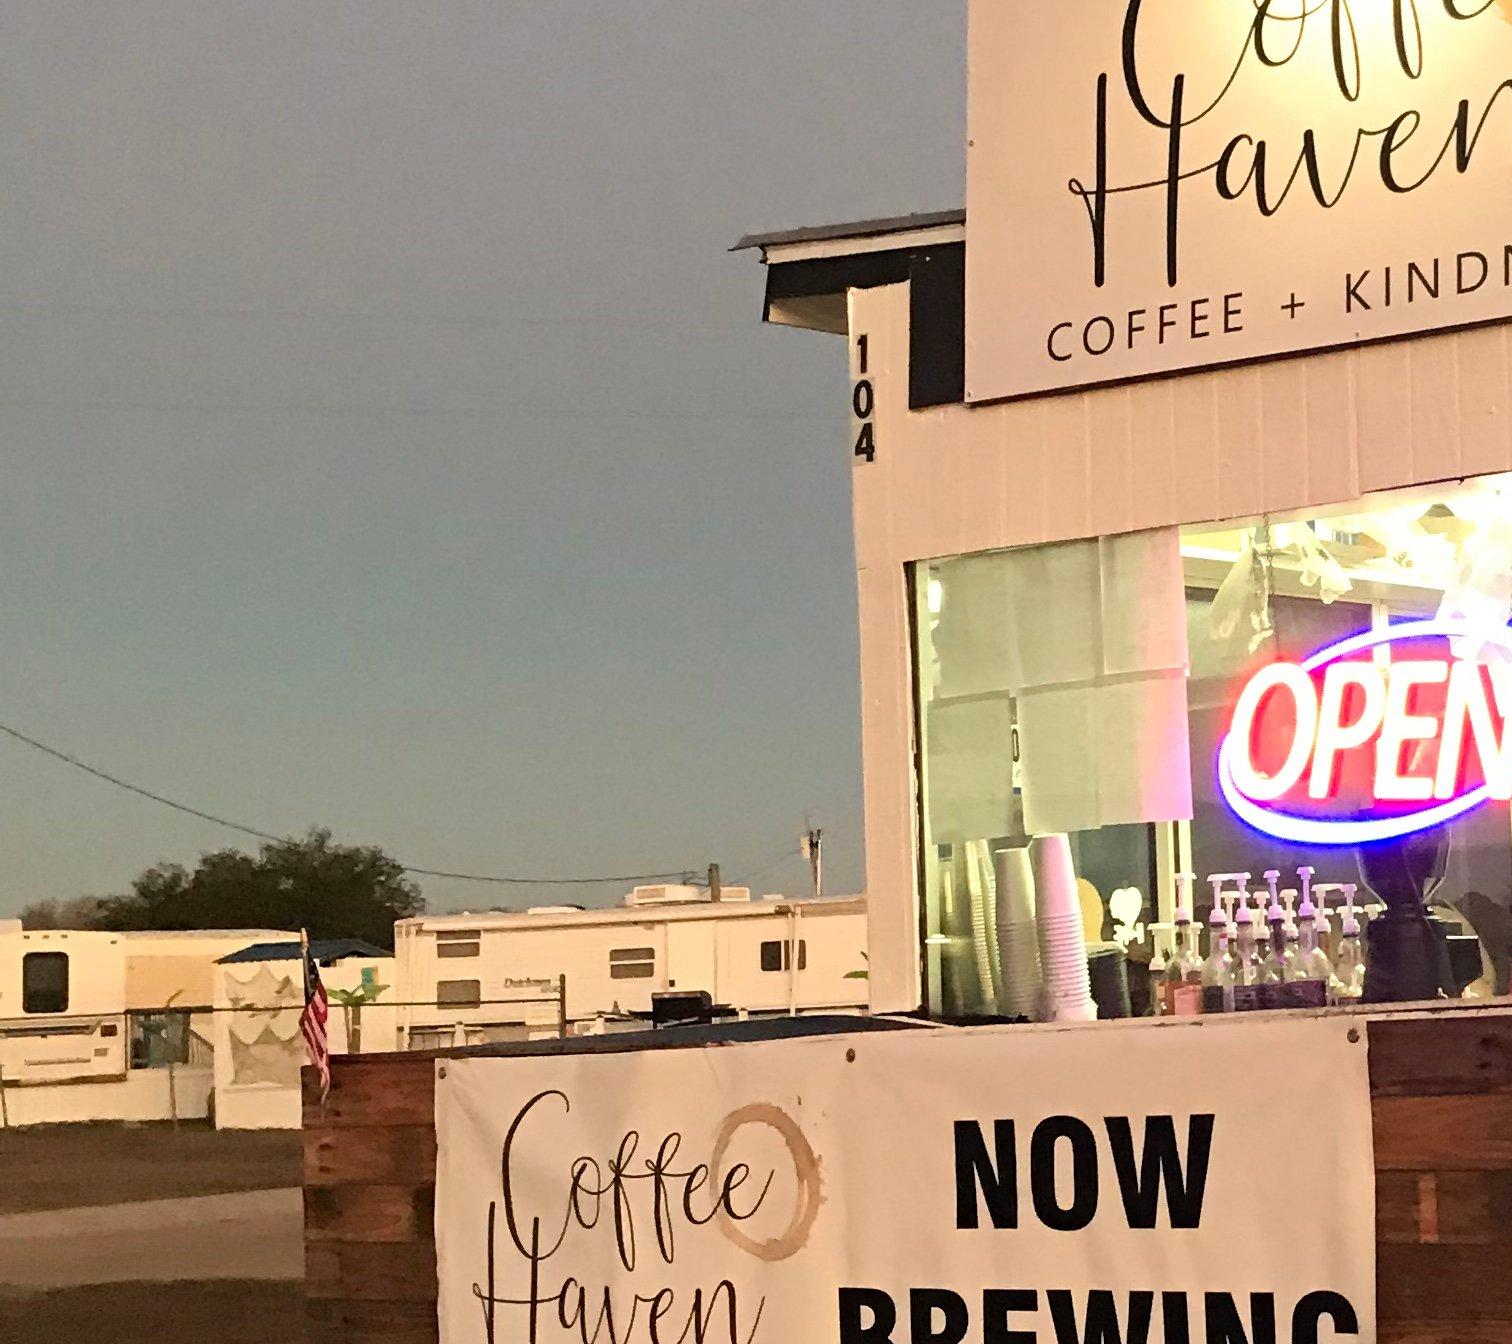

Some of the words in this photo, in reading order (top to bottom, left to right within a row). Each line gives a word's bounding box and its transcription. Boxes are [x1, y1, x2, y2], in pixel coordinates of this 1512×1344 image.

[1047, 291, 1244, 362] COFFEE
[1280, 292, 1306, 320] +
[853, 334, 875, 463] 104
[502, 1089, 774, 1270] Coffee
[953, 1113, 1216, 1232] NOW
